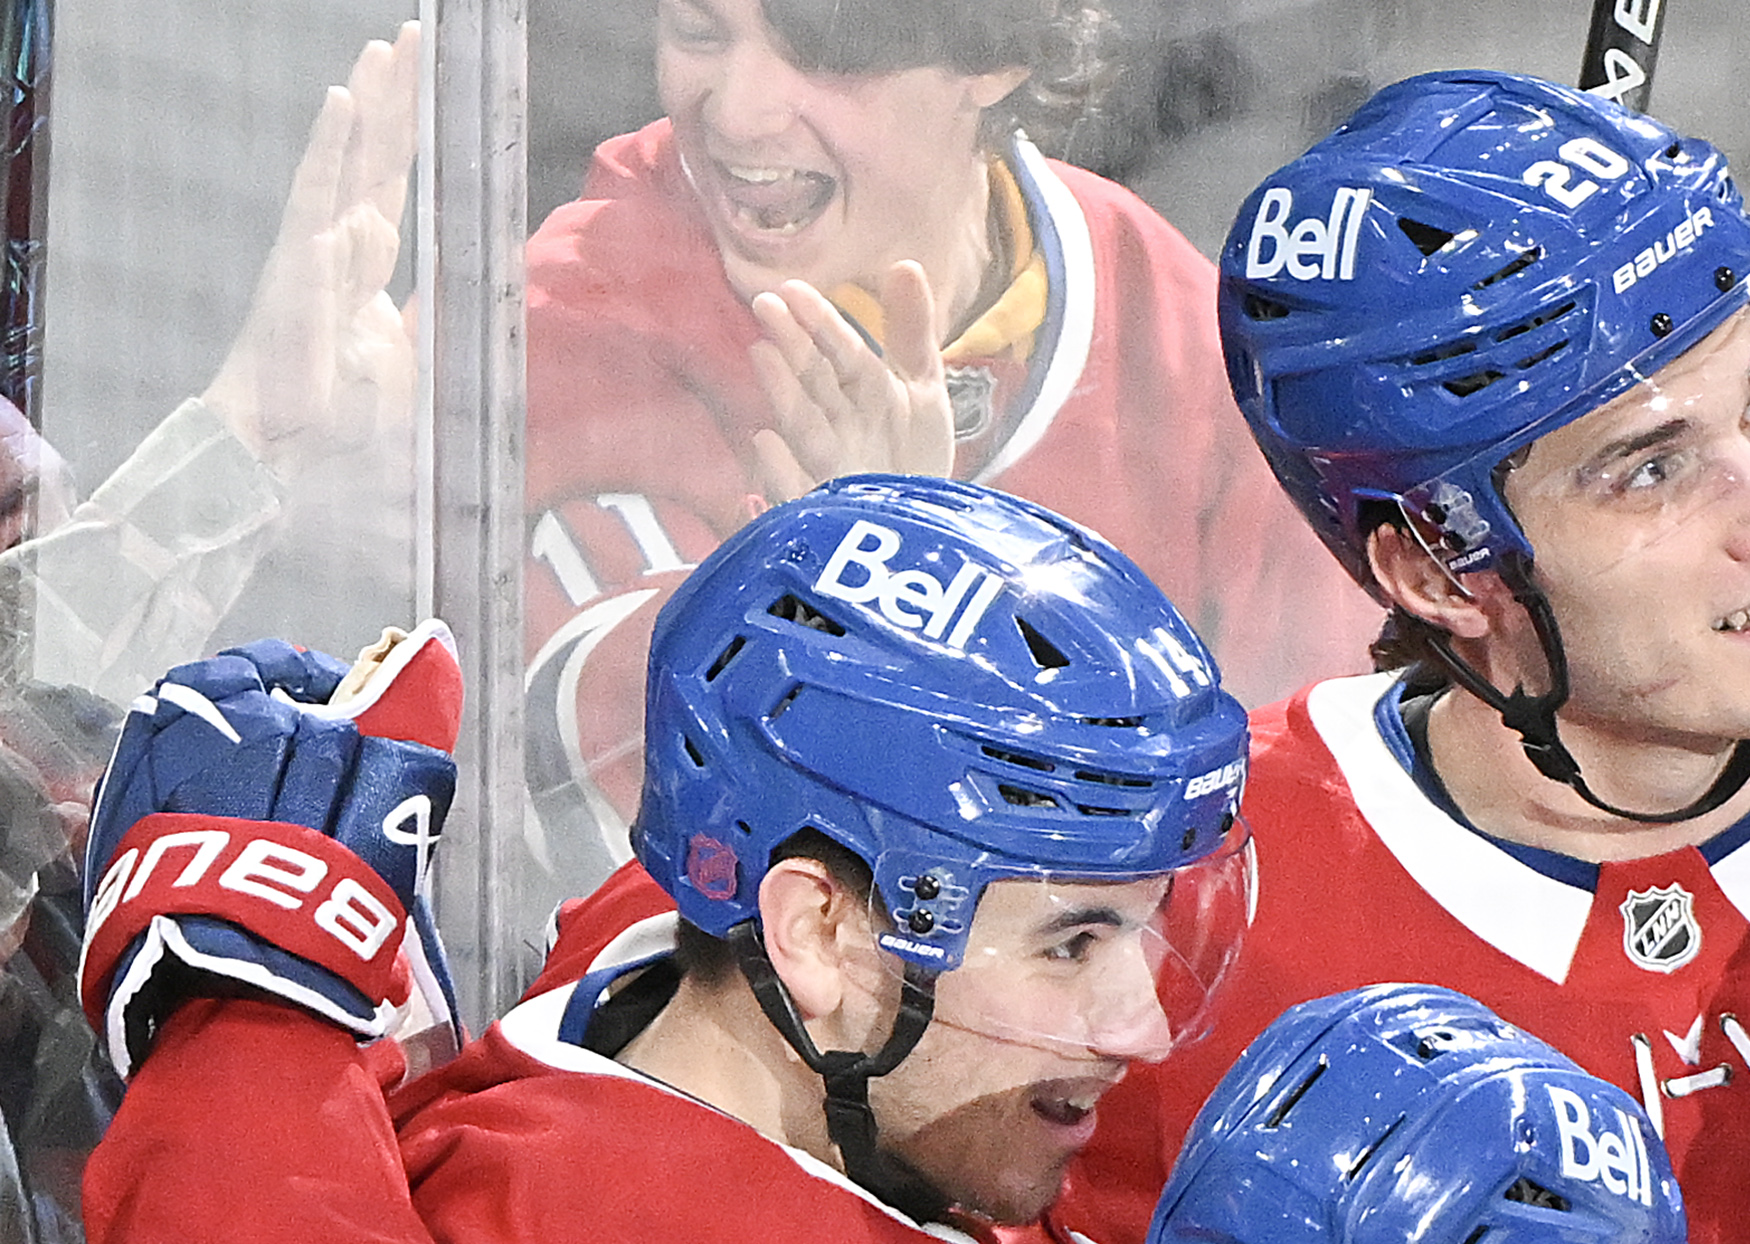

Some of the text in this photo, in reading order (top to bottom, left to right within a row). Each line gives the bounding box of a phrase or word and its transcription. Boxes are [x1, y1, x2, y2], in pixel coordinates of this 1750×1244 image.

[1523, 136, 1629, 210] 20
[1245, 187, 1373, 281] Bell
[1612, 206, 1715, 295] BAUER
[532, 491, 683, 608] 11
[812, 518, 1006, 649] Bell
[1135, 627, 1211, 699] 14
[1544, 1083, 1653, 1207] Bell
